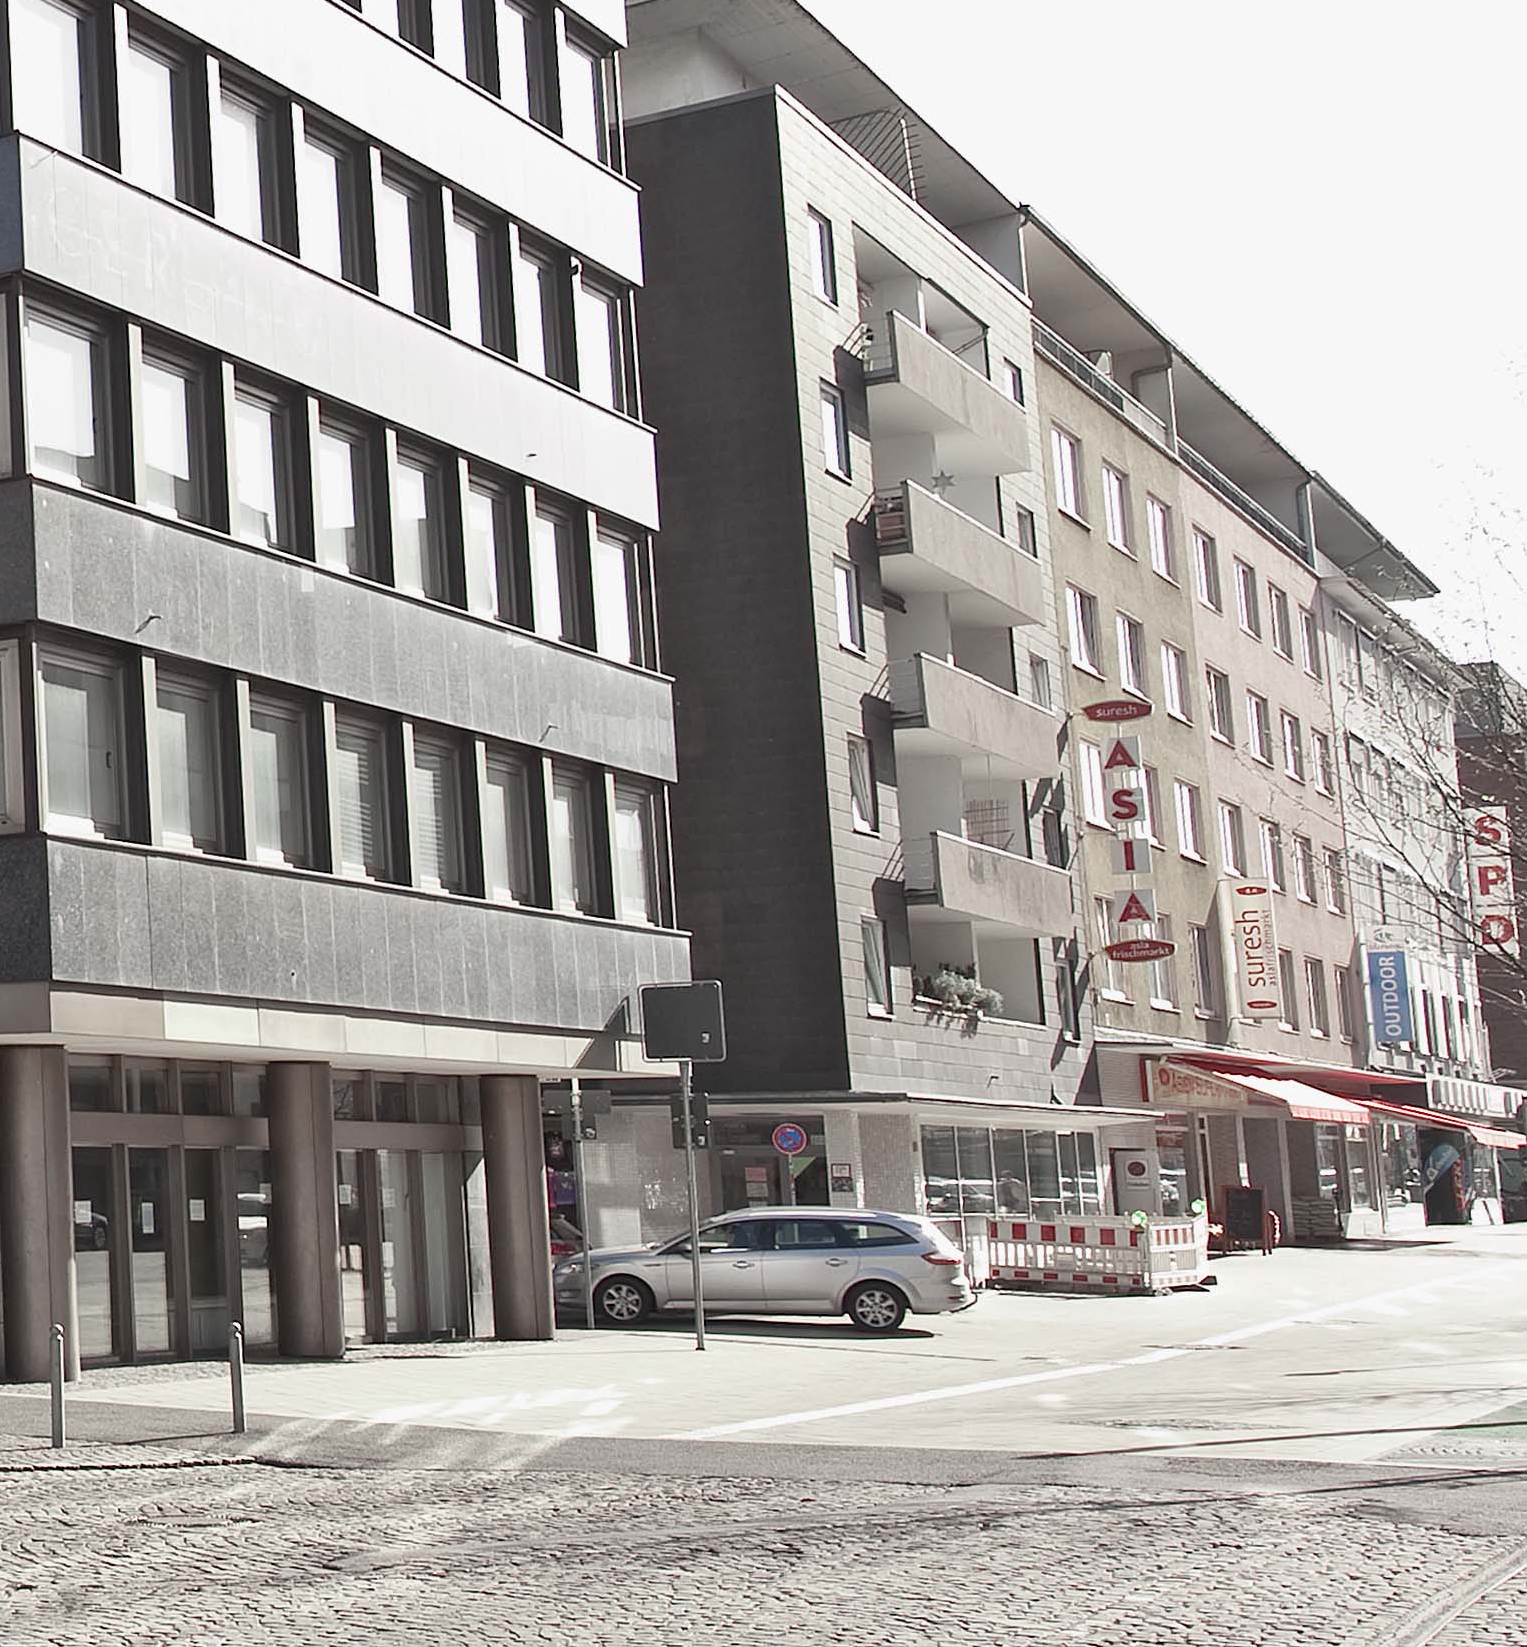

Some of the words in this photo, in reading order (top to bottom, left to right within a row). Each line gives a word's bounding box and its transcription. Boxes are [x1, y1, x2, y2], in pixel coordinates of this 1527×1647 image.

[1096, 705, 1138, 718] suresh
[1104, 740, 1152, 923] ASIA
[1235, 910, 1266, 988] suresh
[1379, 956, 1402, 1037] OUTDOOR
